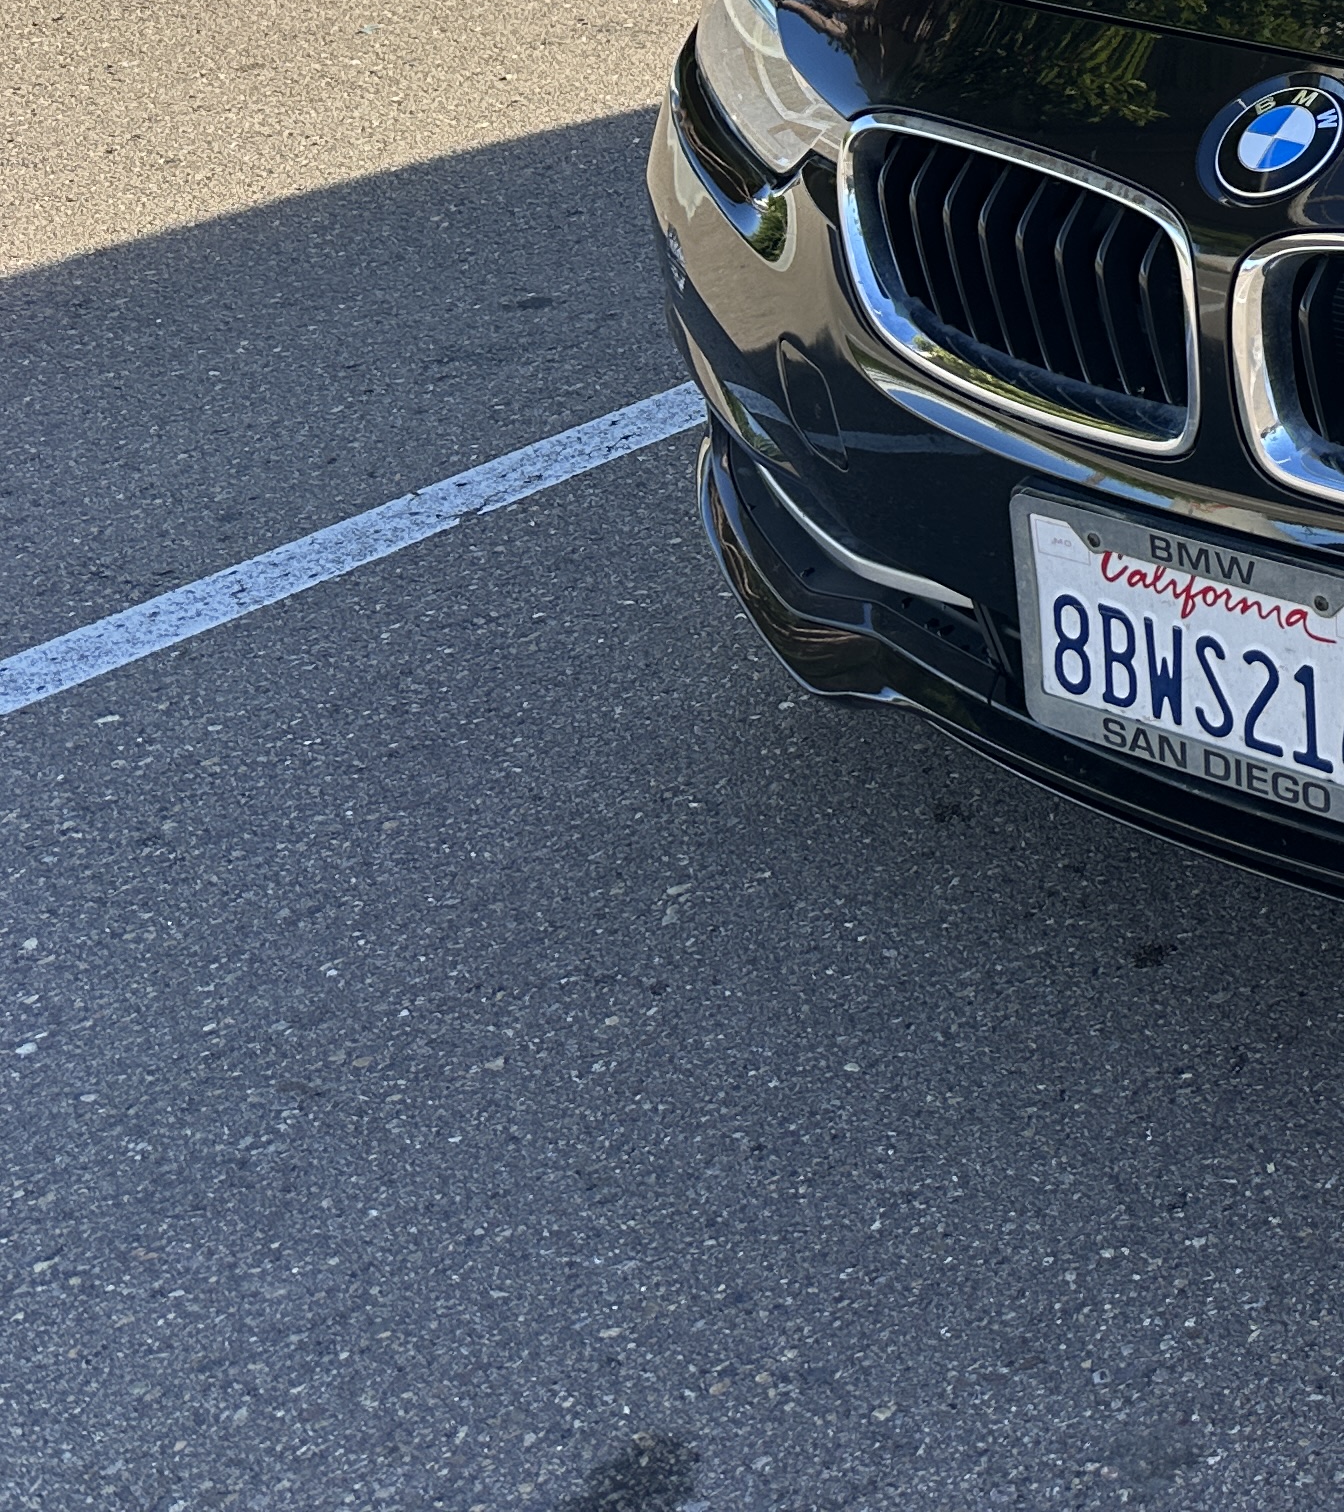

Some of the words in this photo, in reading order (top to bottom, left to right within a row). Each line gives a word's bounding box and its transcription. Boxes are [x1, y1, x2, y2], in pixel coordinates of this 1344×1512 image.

[1255, 89, 1338, 129] BMW
[1149, 534, 1256, 585] BMW
[1100, 550, 1338, 644] California
[1102, 717, 1188, 769] SAN
[1203, 758, 1332, 814] DIEGO
